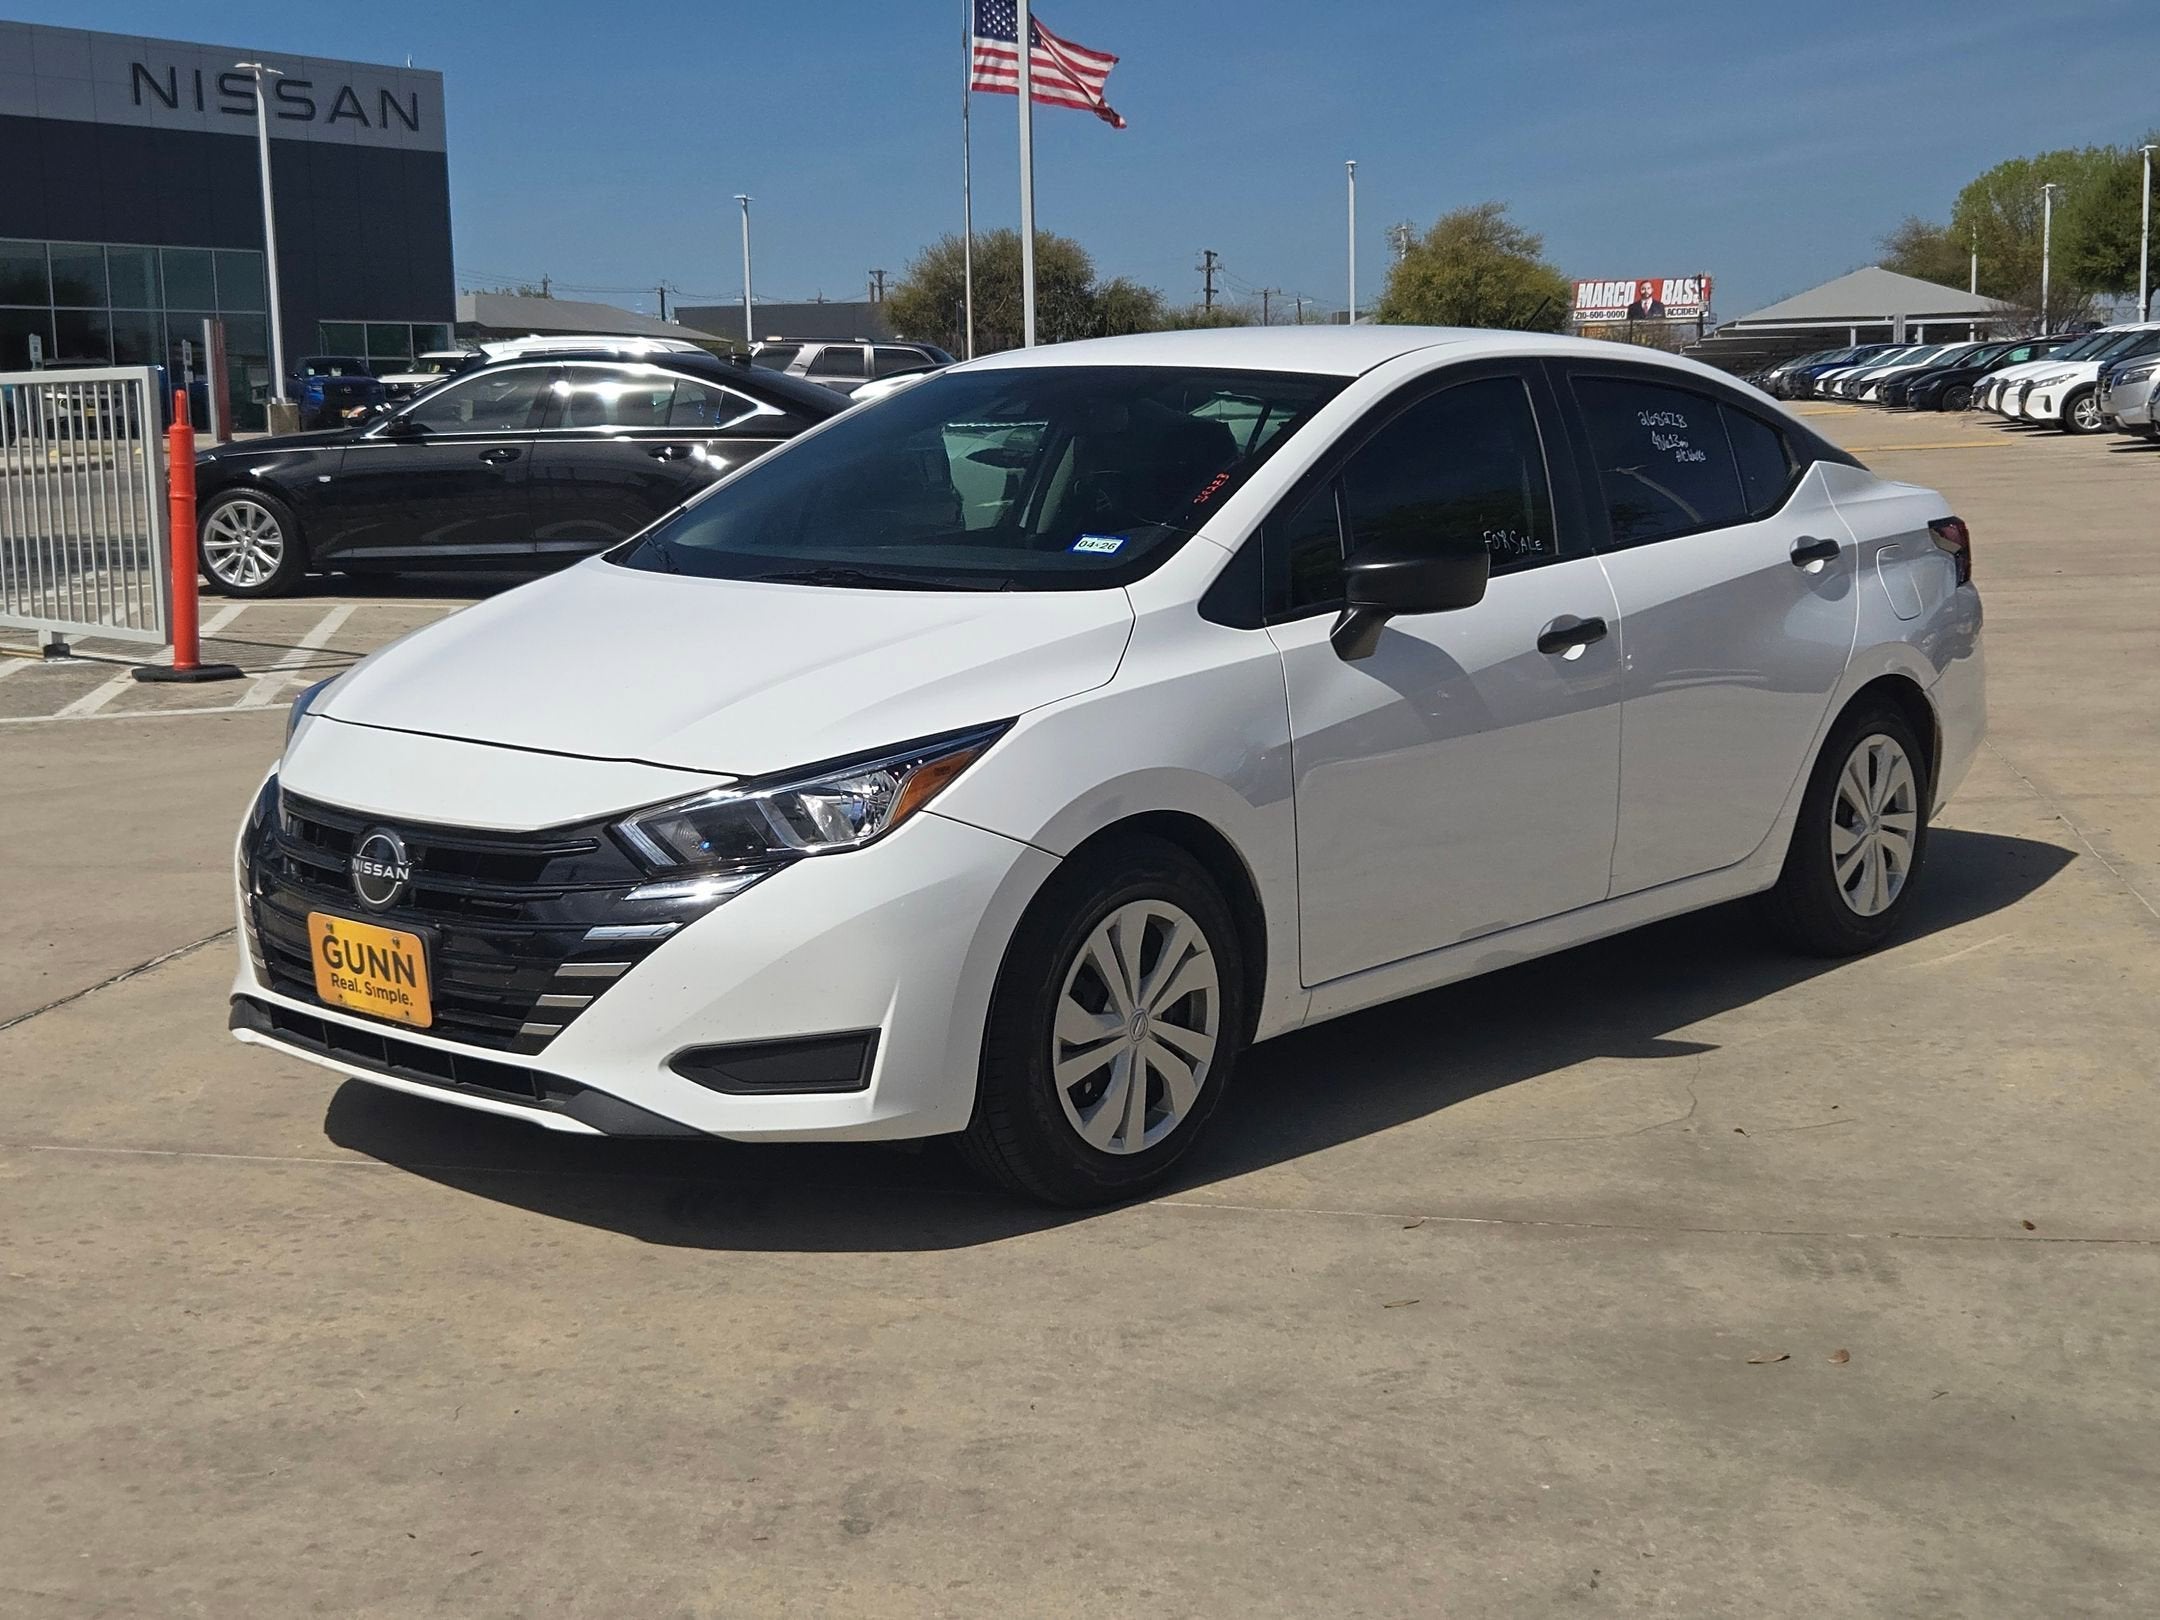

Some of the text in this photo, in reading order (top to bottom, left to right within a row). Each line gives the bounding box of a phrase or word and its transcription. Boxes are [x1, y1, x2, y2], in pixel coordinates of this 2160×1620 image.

[130, 62, 420, 132] NISSAN
[1576, 281, 1636, 309] MARCO
[1575, 309, 1626, 320] 210-600-0000
[352, 858, 410, 881] NISSAN
[322, 934, 417, 988] GUNN
[331, 973, 414, 1006] Real. Simple.
